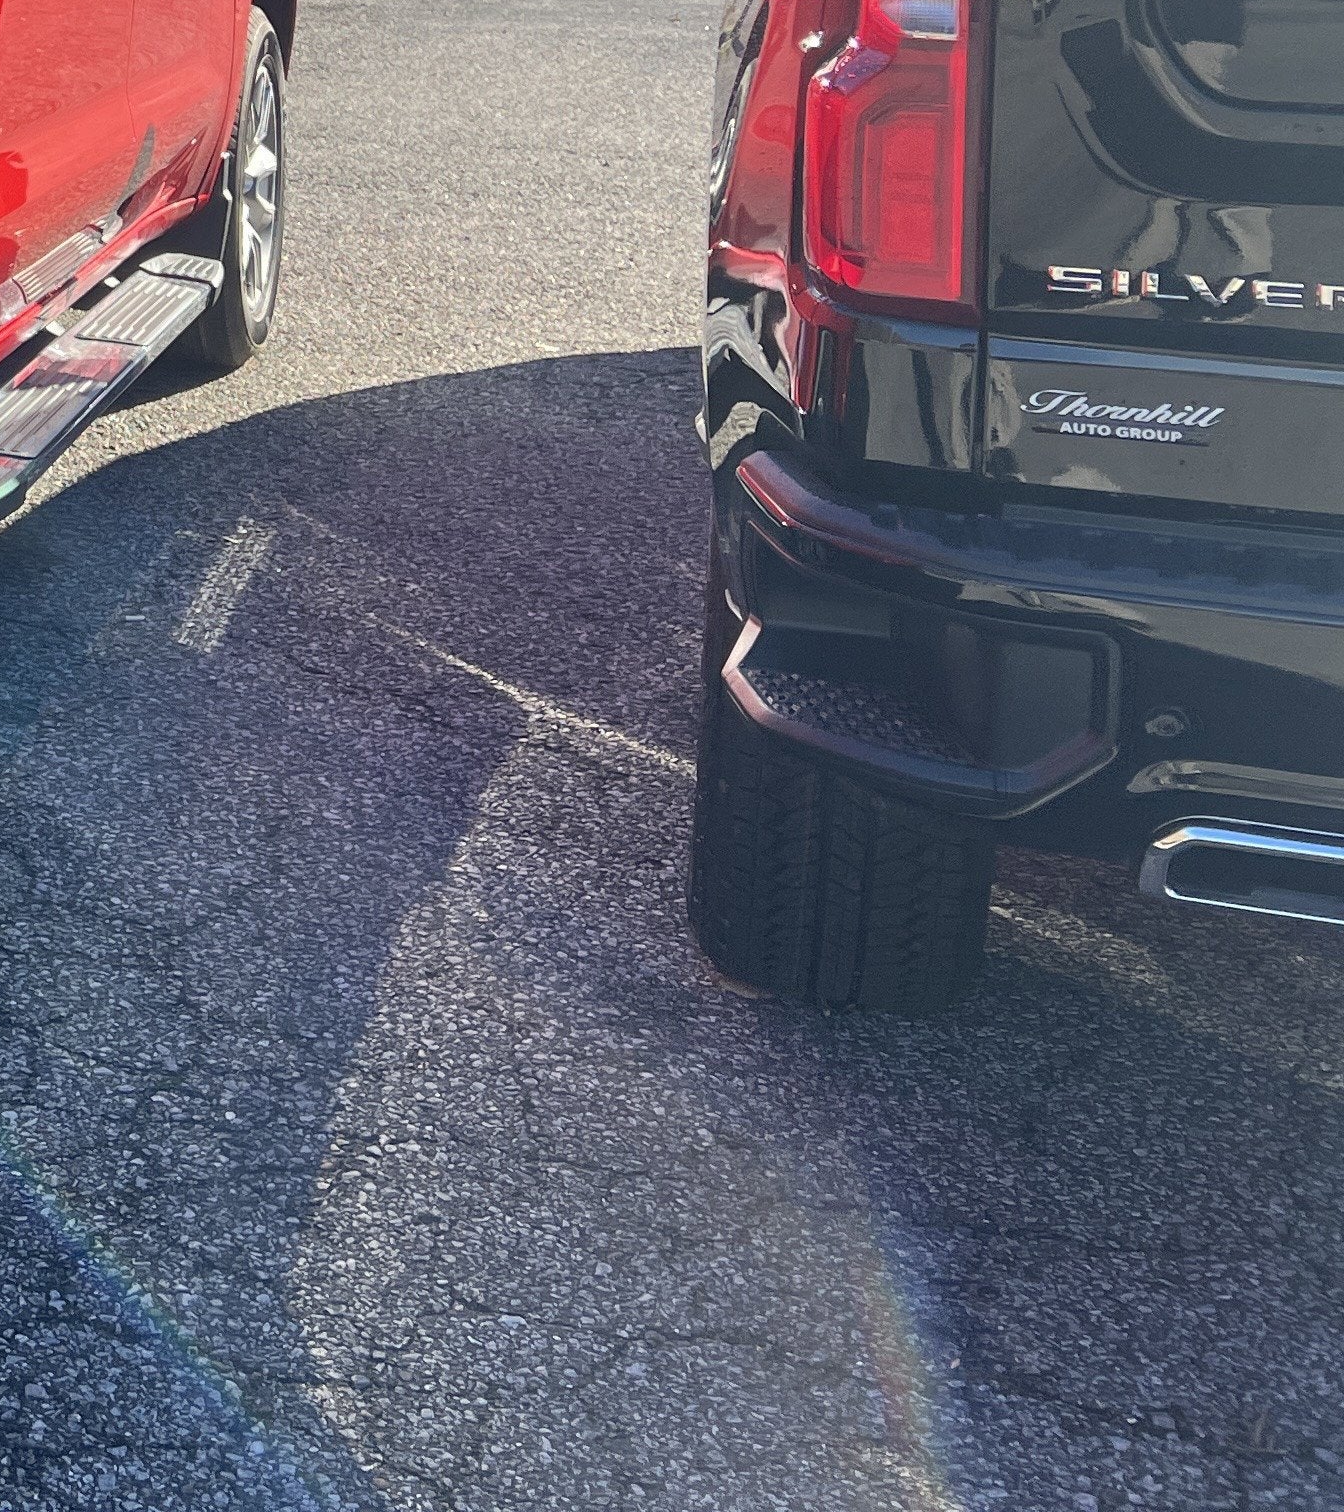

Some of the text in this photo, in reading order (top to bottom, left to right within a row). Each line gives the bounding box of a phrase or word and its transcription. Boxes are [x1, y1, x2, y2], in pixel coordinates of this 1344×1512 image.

[1020, 389, 1226, 428] Thornhill
[1059, 421, 1183, 444] AUTO GROUP
